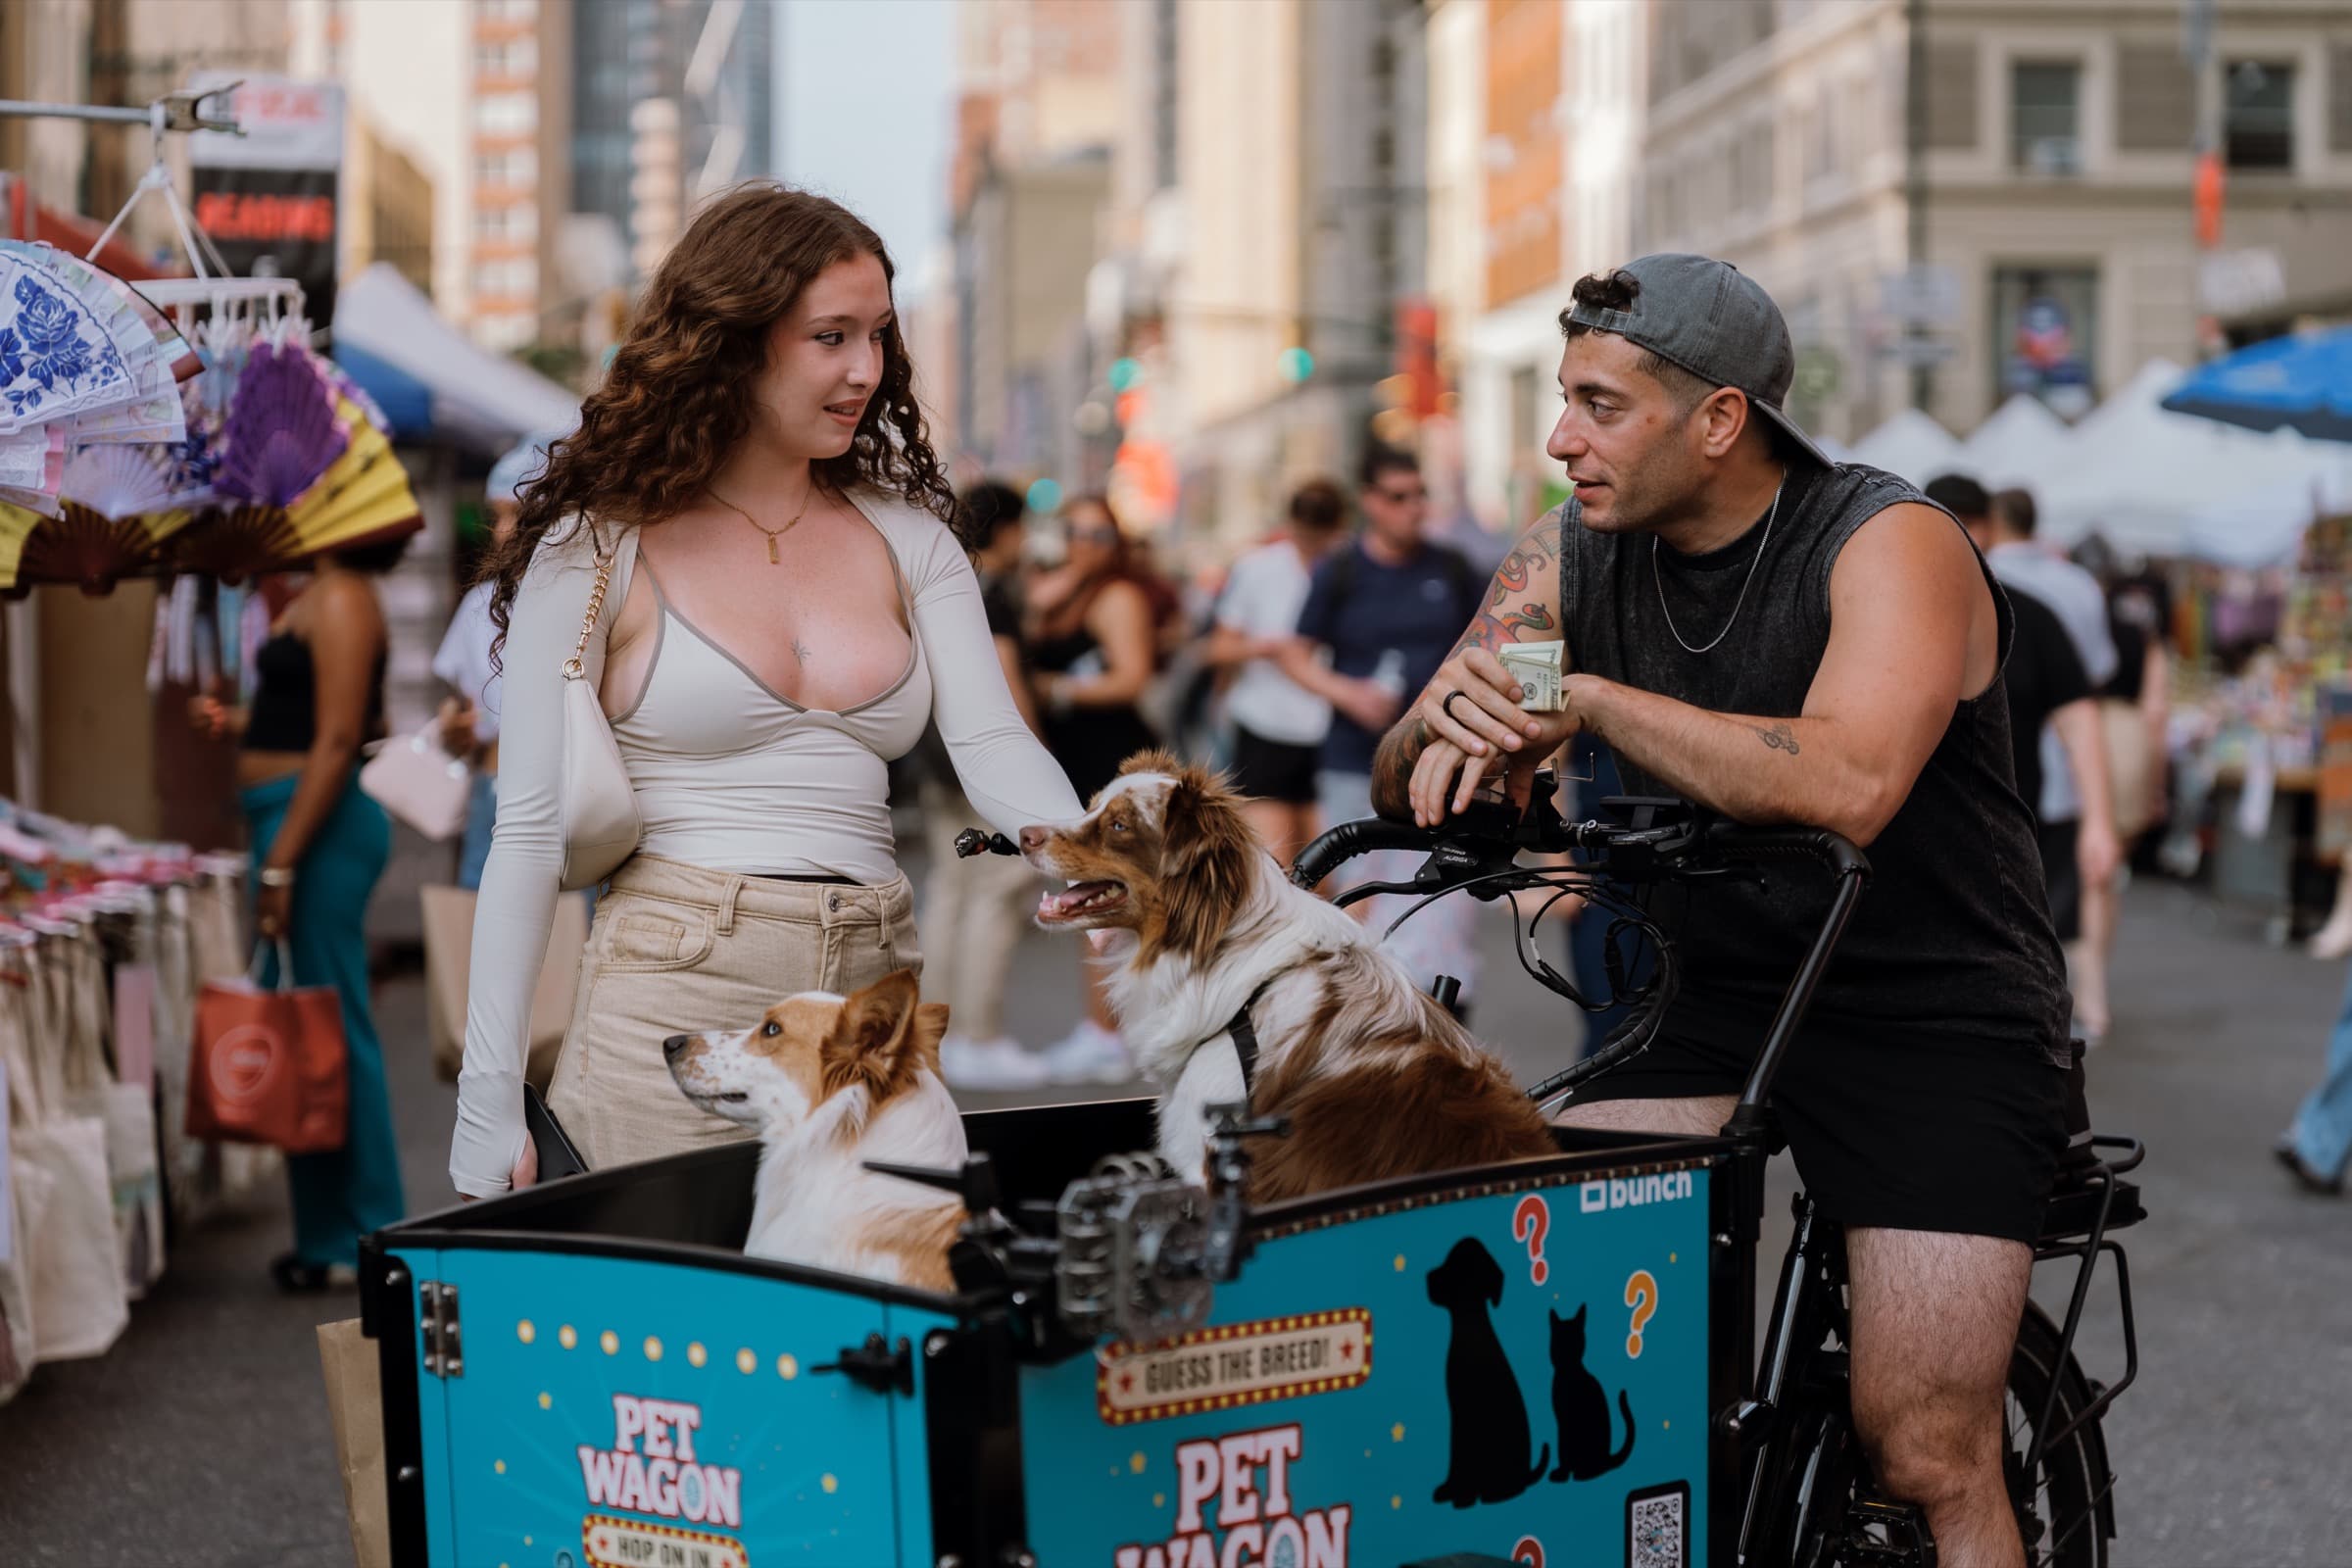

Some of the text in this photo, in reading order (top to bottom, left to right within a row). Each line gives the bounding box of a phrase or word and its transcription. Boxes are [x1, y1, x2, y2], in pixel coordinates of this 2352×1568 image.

[1610, 1170, 1691, 1209] bunch
[1145, 1337, 1330, 1395] GUESS THE BREED!
[612, 1393, 701, 1463] PET
[577, 1444, 740, 1530] WAGON
[1175, 1422, 1302, 1534] PET
[617, 1536, 710, 1568] HOP ON IN
[1114, 1501, 1351, 1568] GON
